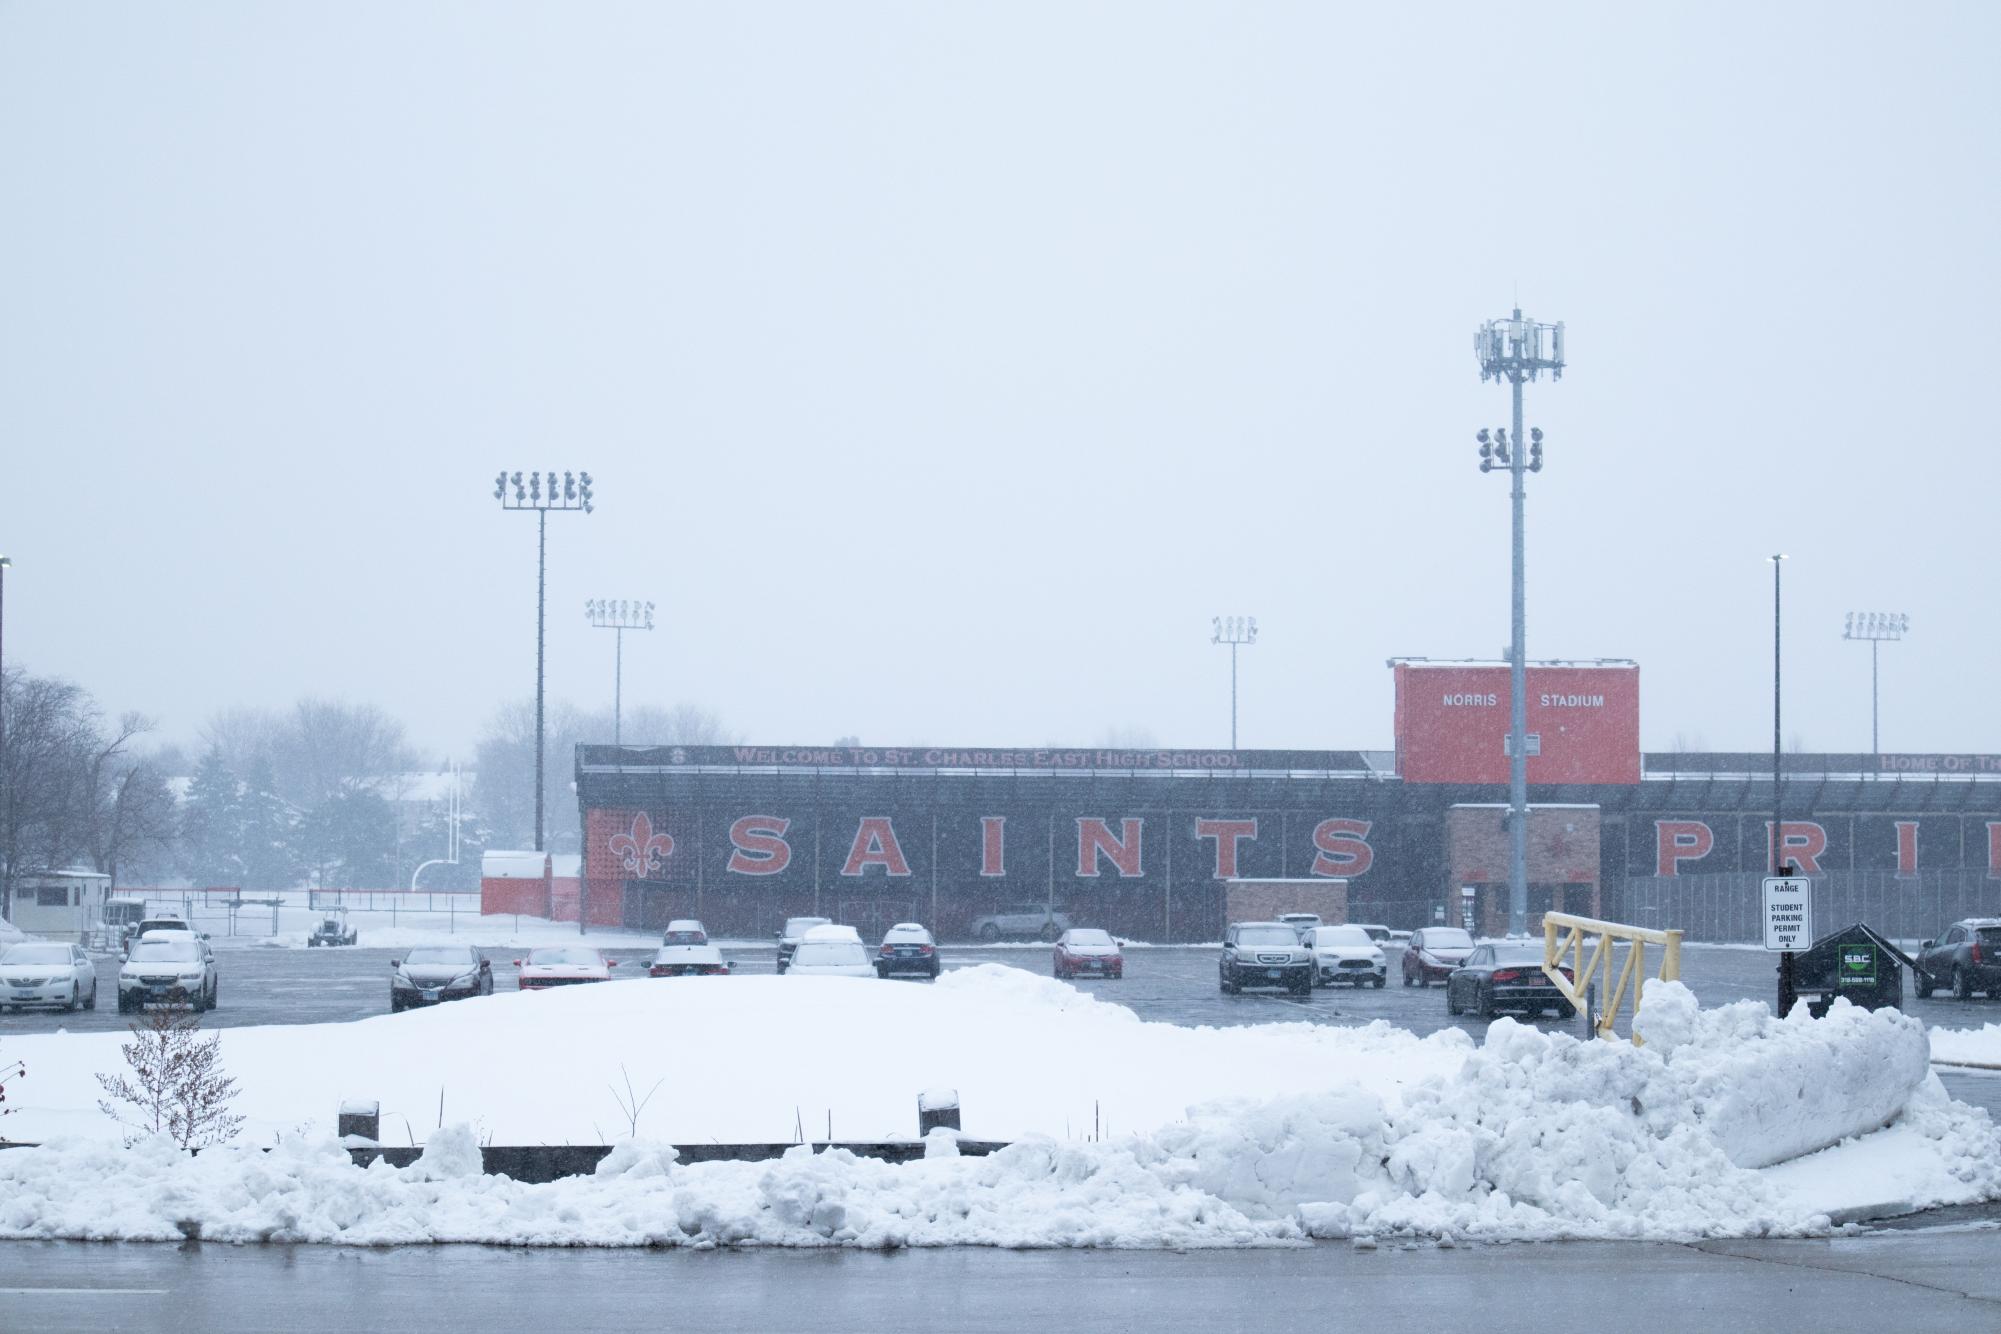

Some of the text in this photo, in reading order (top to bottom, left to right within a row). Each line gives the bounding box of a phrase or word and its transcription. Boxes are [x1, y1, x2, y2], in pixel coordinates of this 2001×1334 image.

[1443, 693, 1604, 707] NORRIS STADIUM
[726, 814, 1374, 878] SAINTS
[1654, 820, 2001, 879] PRI
[1774, 885, 1799, 893] RANGE
[1771, 914, 1803, 922] PARKING
[1774, 924, 1801, 932] PERMIT
